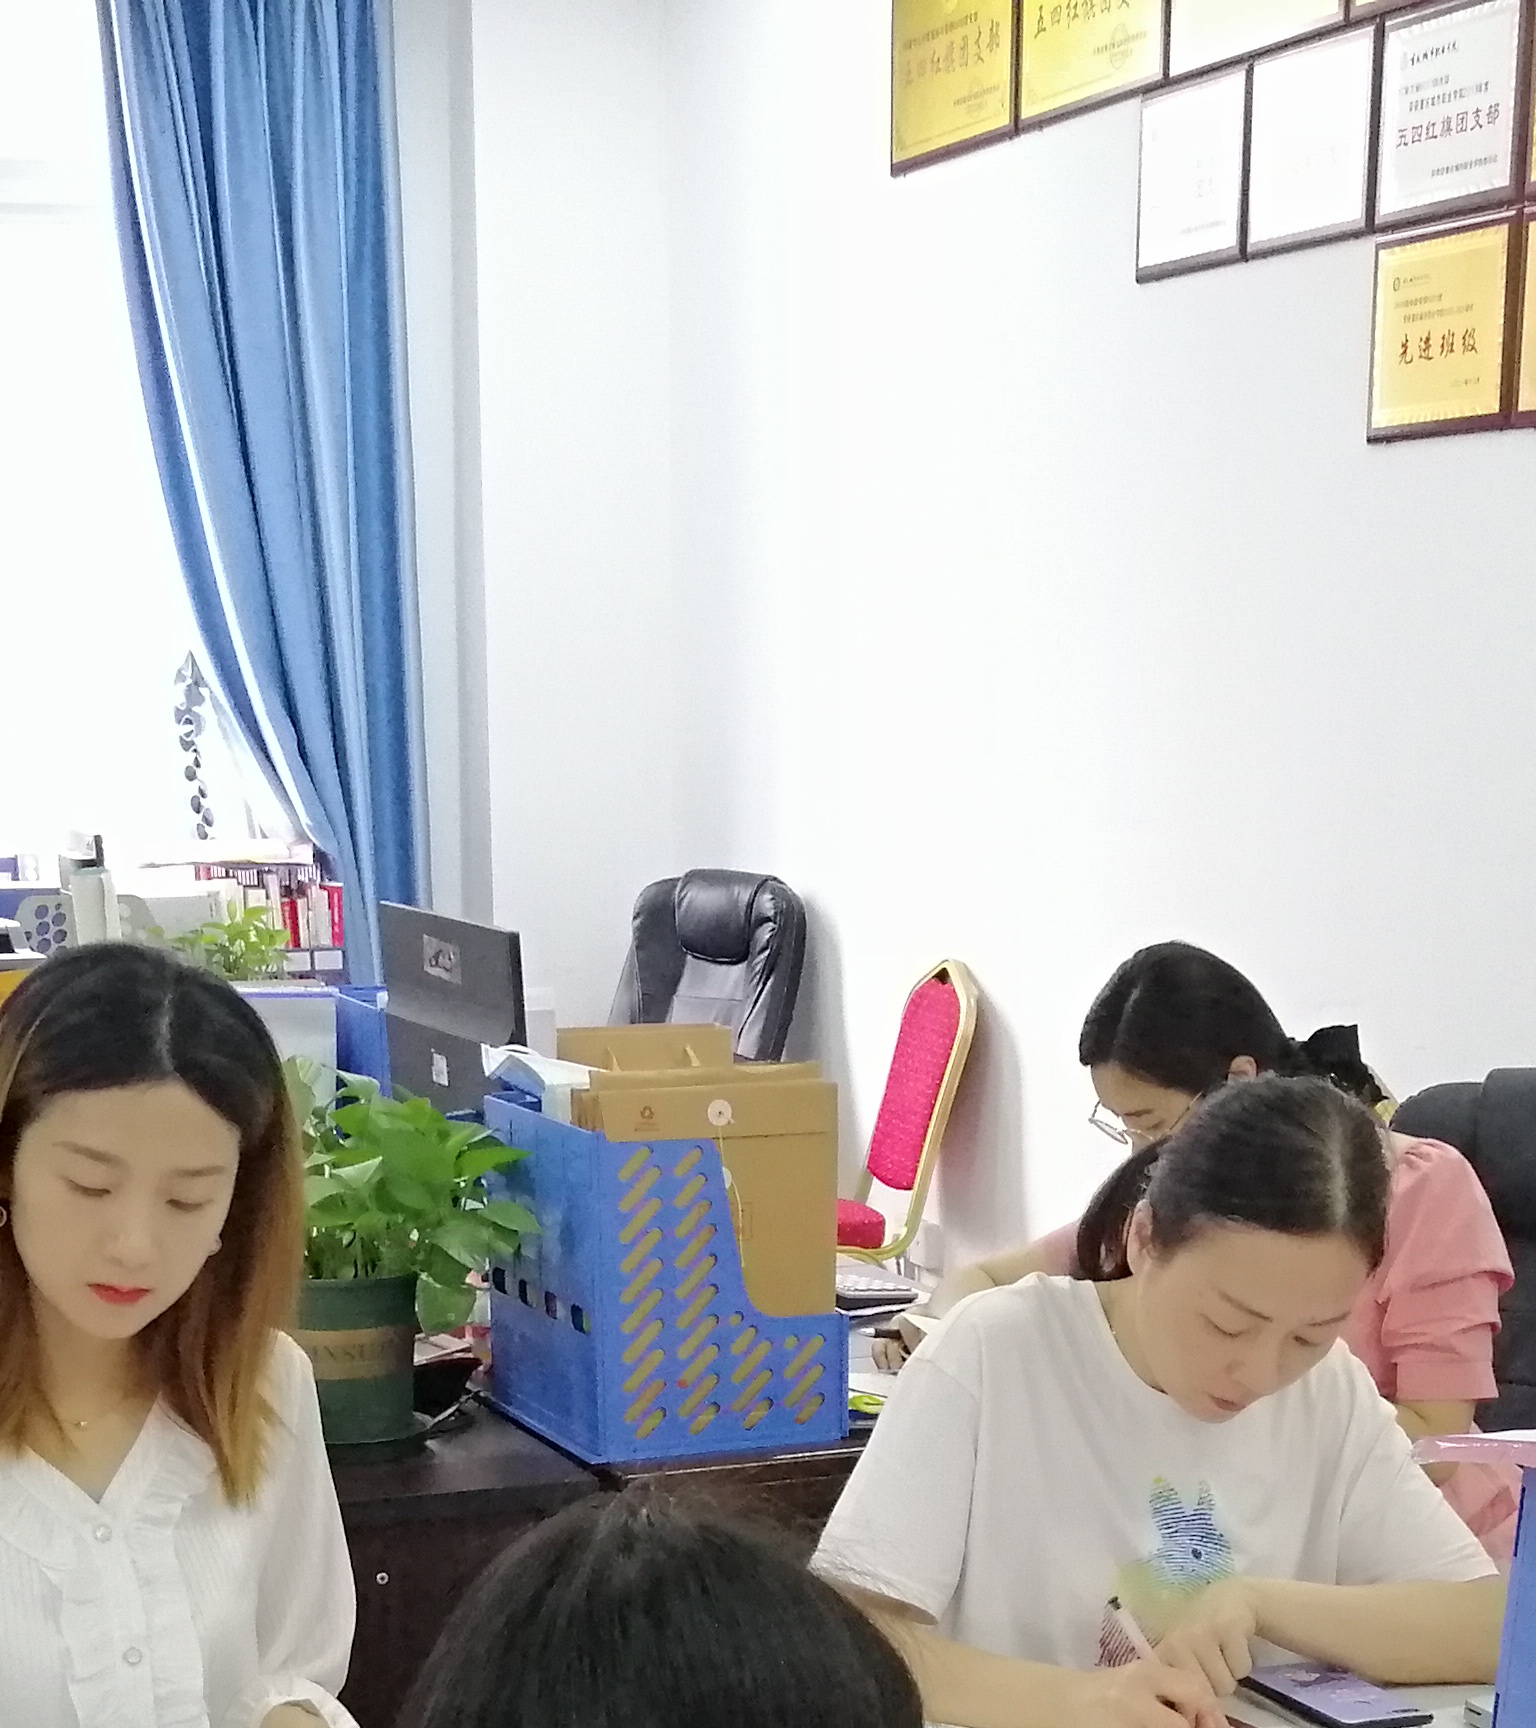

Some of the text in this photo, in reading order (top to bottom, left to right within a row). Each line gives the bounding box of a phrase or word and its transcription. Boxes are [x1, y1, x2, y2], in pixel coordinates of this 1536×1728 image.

[1396, 103, 1500, 148] 五四红旗团支部
[1399, 328, 1478, 365] 先进班级
